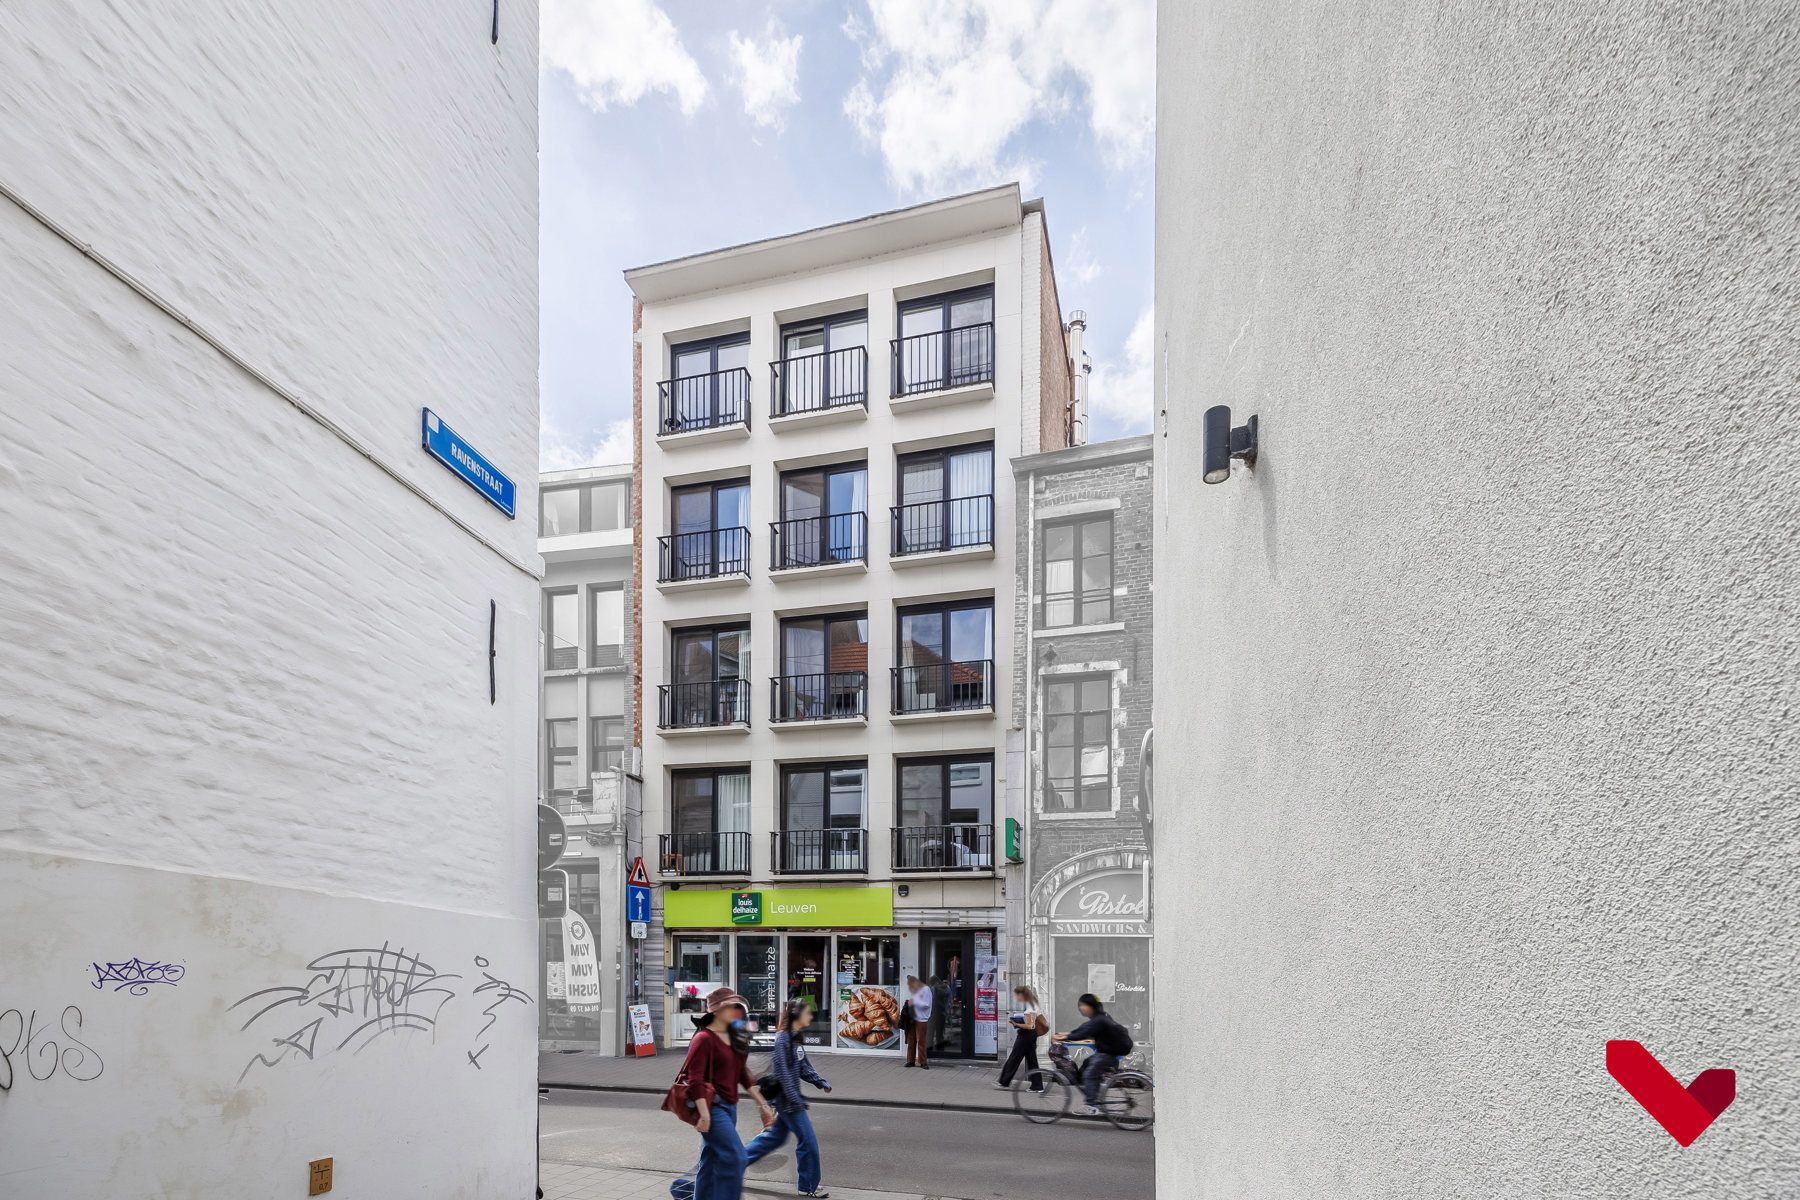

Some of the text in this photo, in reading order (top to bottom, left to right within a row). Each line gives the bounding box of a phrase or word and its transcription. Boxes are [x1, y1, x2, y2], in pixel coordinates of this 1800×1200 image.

[451, 442, 504, 496] RAVENSTRAAT
[738, 898, 753, 906] louis
[770, 901, 817, 914] Leuven
[732, 906, 758, 914] delhaize
[1056, 923, 1148, 934] SANDWICHS &
